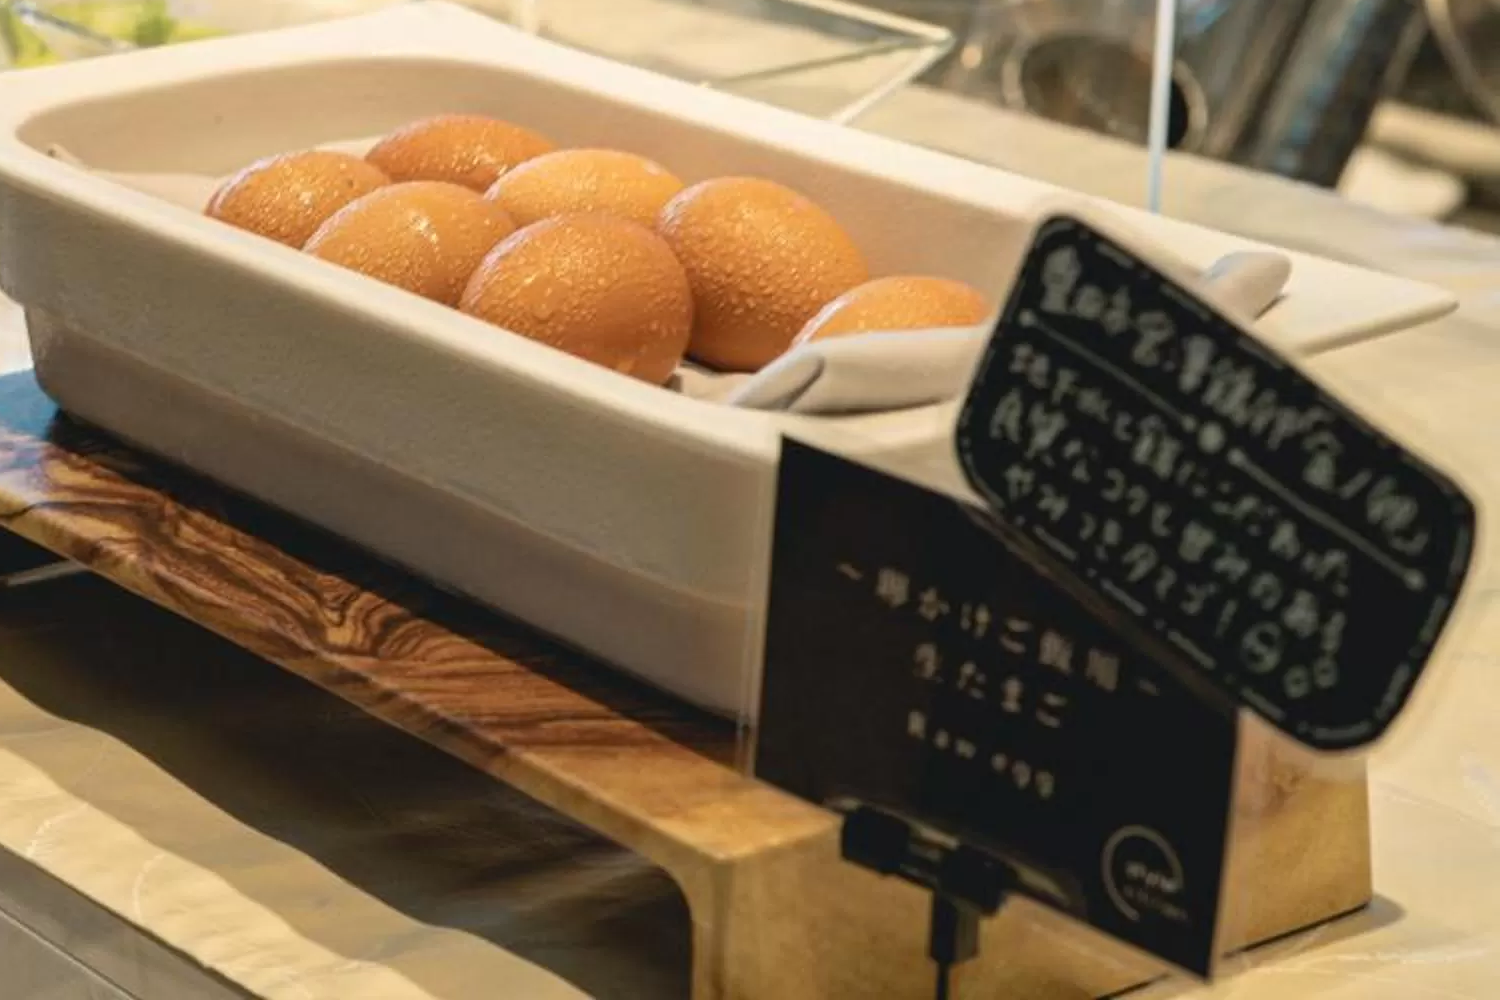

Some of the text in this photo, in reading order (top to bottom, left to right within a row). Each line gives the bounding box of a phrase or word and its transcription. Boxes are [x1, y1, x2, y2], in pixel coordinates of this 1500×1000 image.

[913, 642, 1068, 729] 生たまご
[907, 709, 1059, 800] Raw egg
